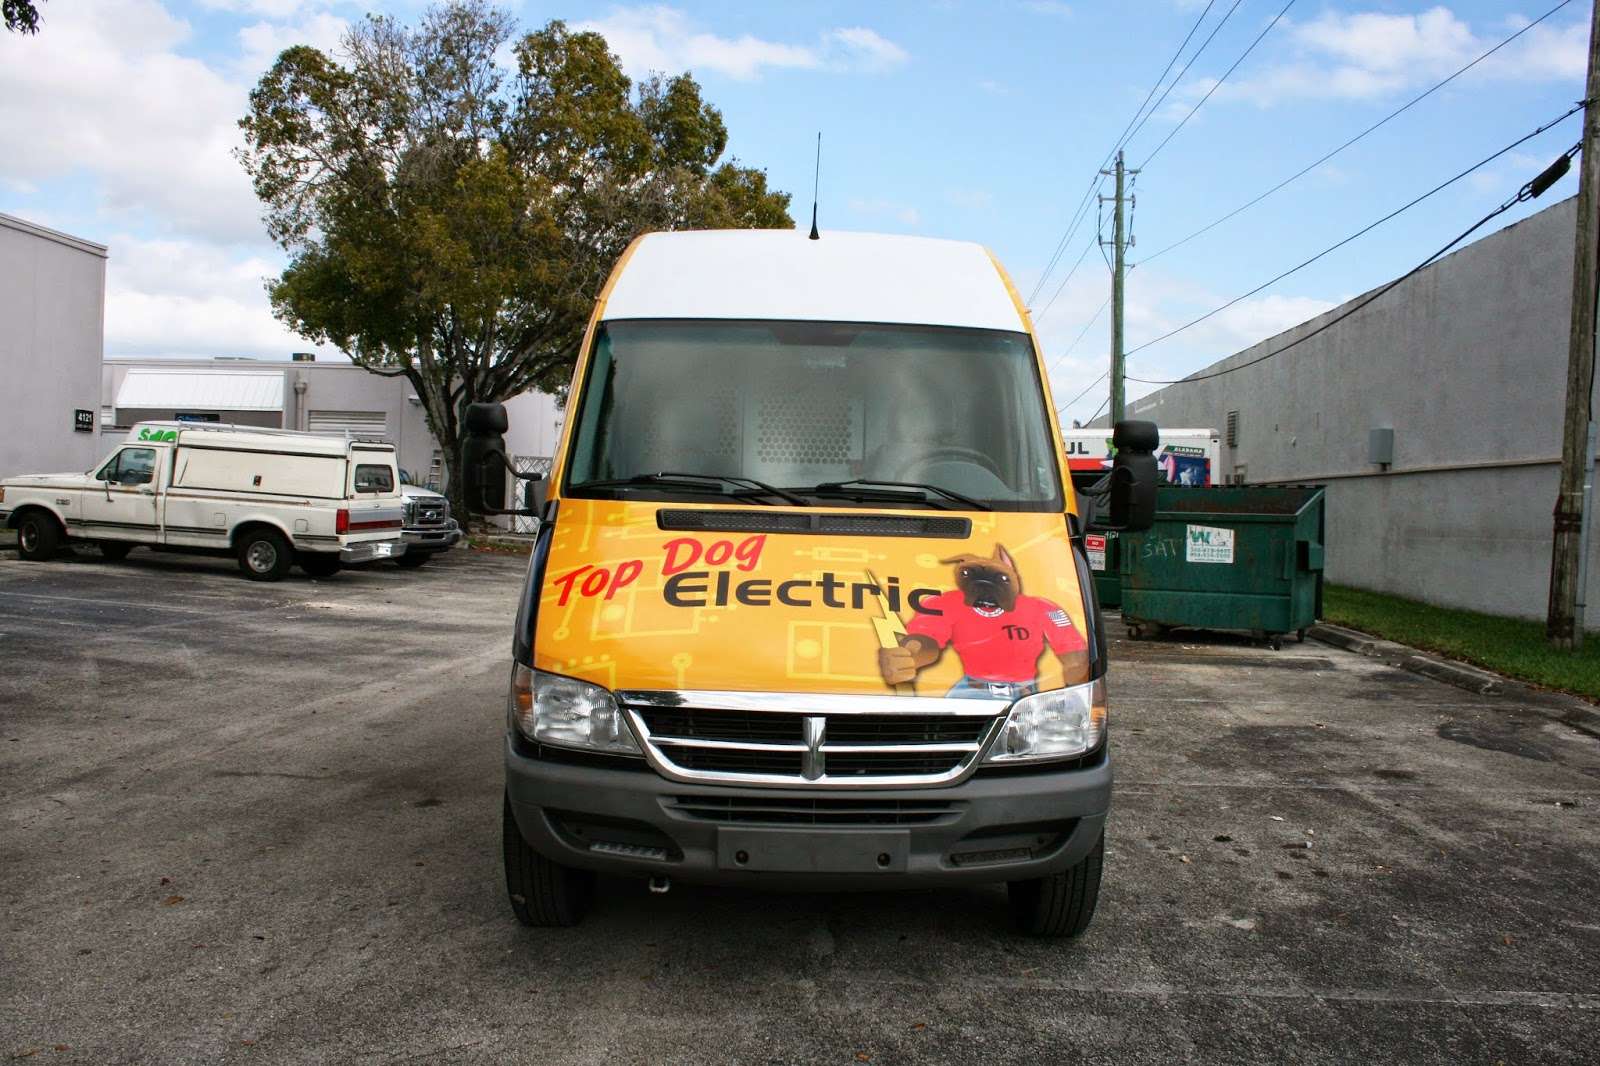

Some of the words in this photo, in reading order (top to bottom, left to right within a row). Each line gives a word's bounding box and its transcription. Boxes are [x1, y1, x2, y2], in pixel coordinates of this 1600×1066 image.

[661, 534, 768, 577] Dog
[662, 570, 944, 617] Electric
[1002, 624, 1030, 641] TD
